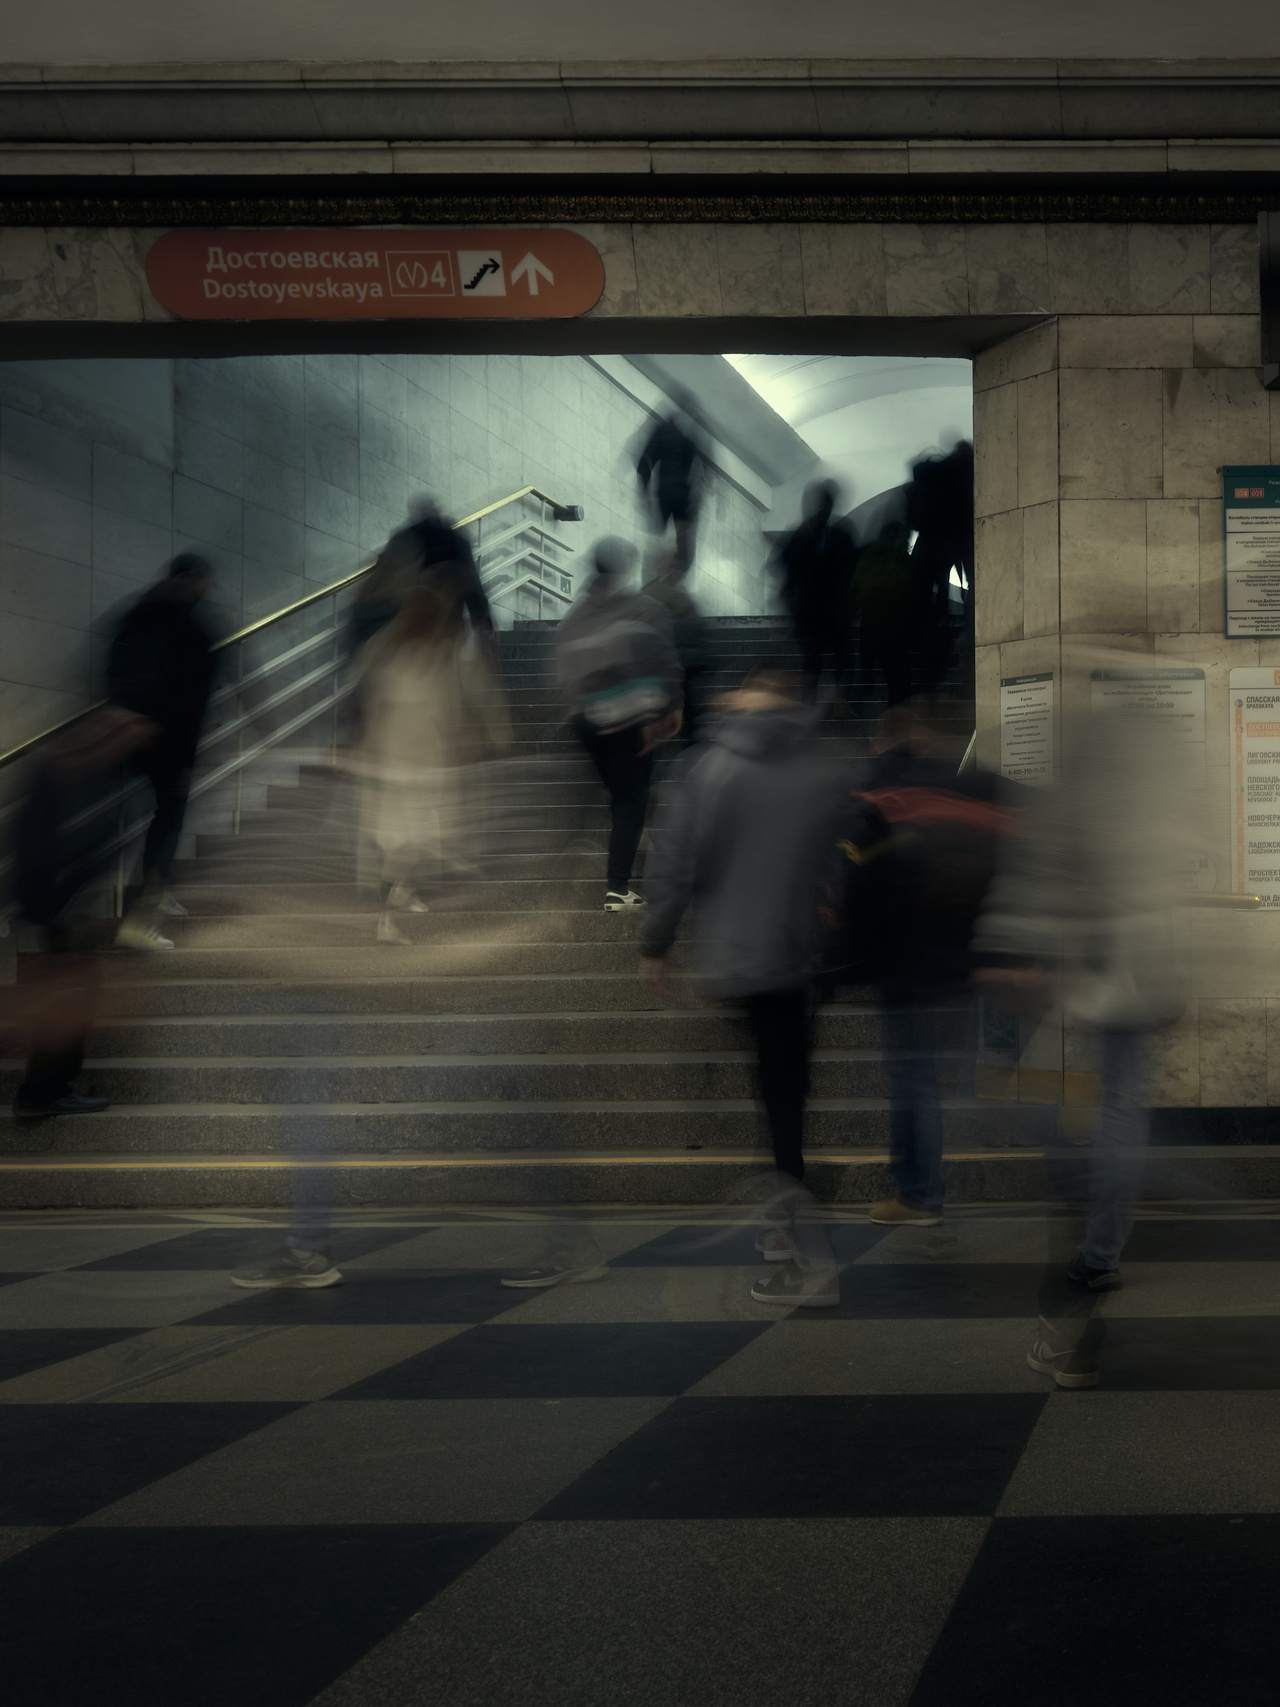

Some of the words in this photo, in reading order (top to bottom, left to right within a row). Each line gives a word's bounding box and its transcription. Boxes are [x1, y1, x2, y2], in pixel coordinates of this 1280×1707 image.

[206, 247, 379, 272] Достоевская
[203, 277, 383, 303] Dostoyevskaya
[1247, 776, 1280, 784] ПЛОЩАДЬ
